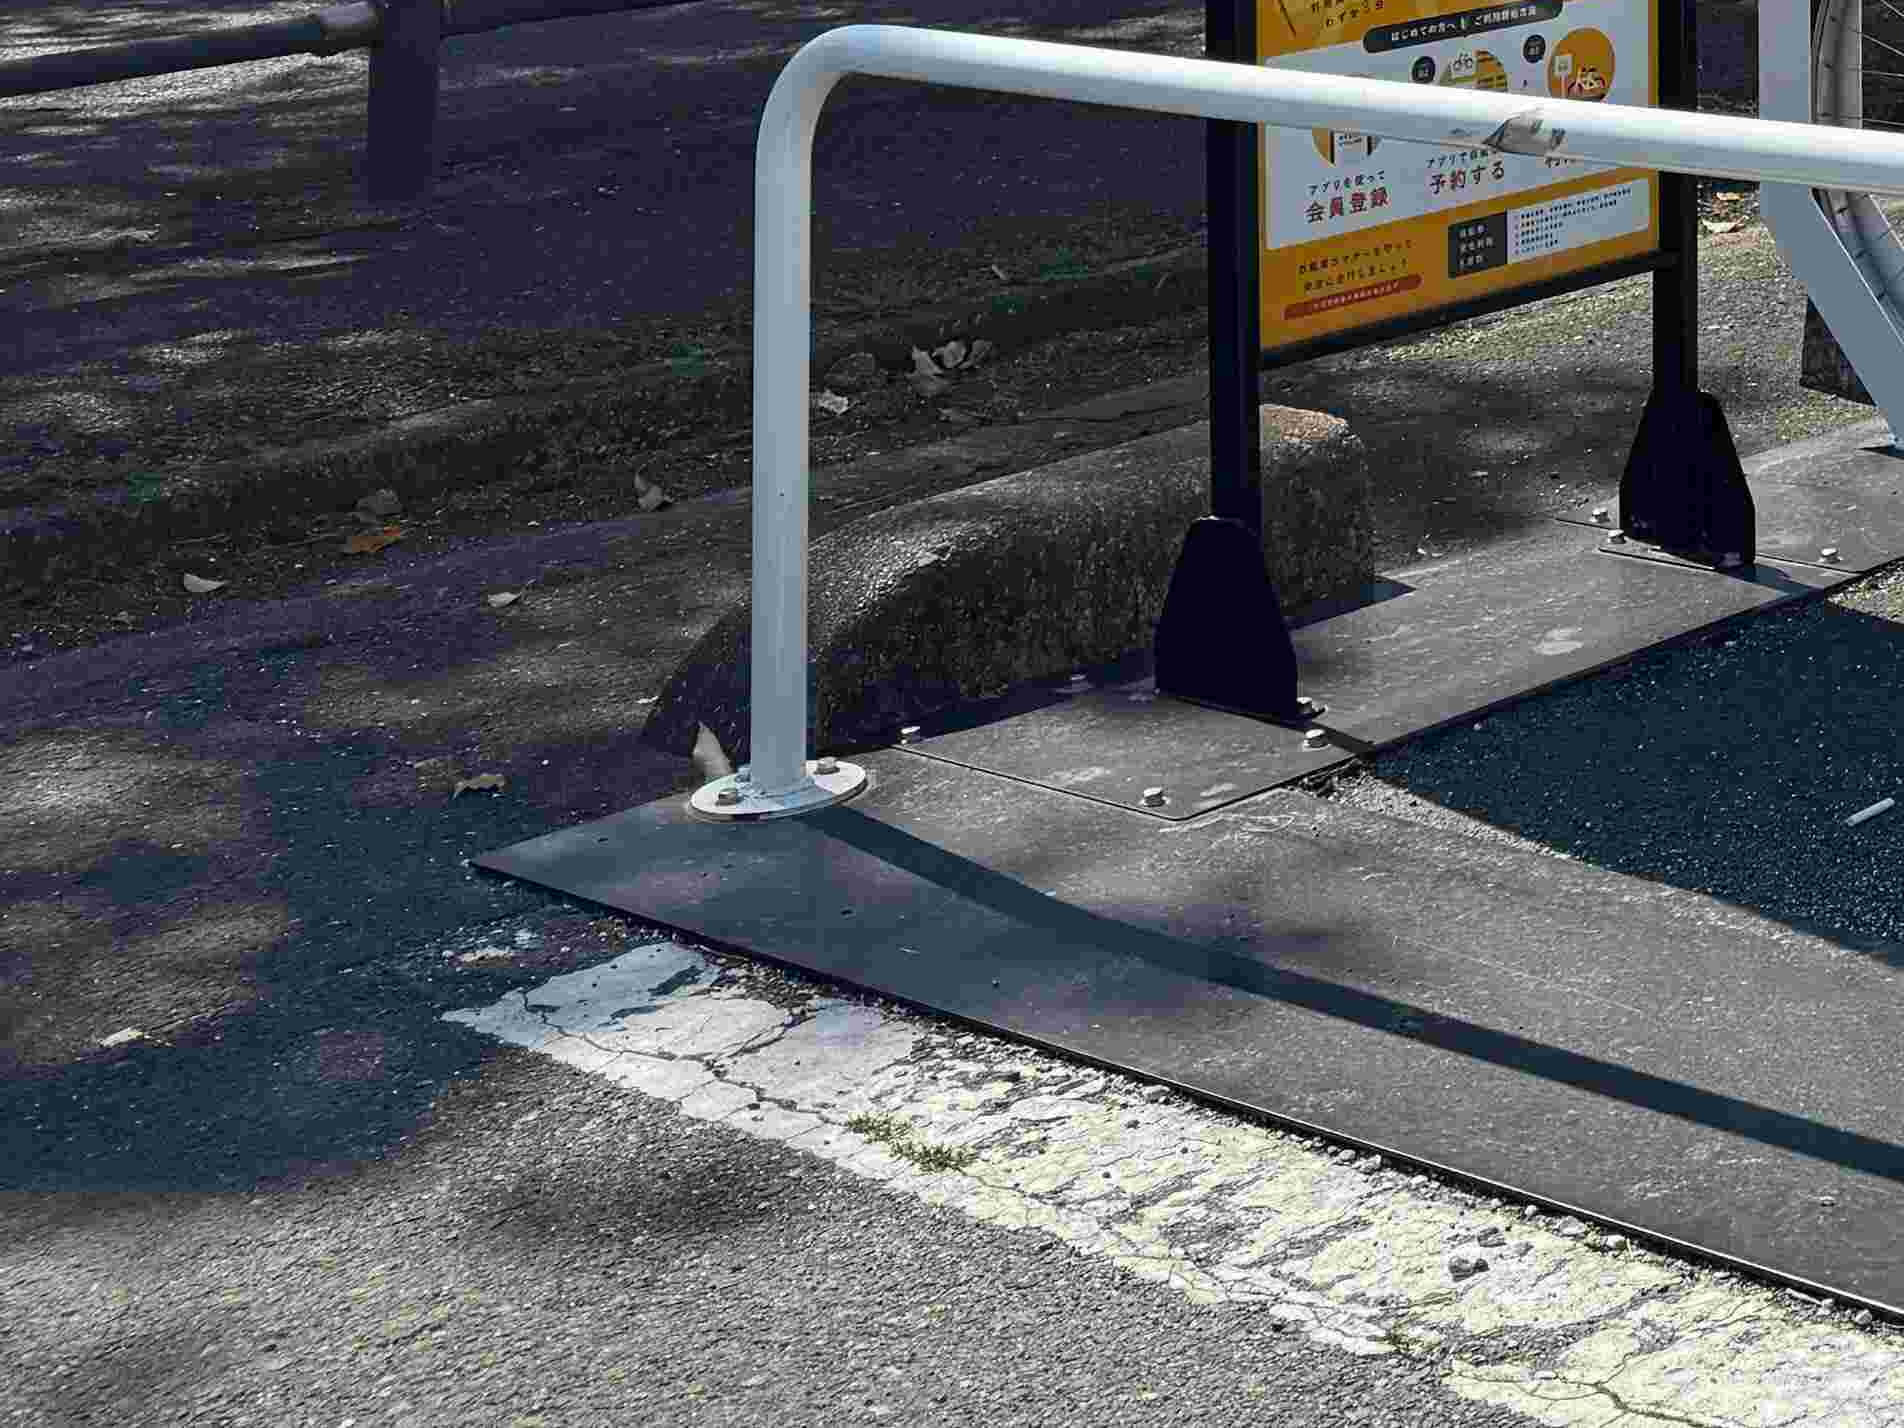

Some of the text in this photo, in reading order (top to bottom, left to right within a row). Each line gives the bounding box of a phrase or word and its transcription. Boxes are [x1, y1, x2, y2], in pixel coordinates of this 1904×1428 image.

[1428, 160, 1506, 195] 予約する
[1304, 185, 1391, 225] 会員登録
